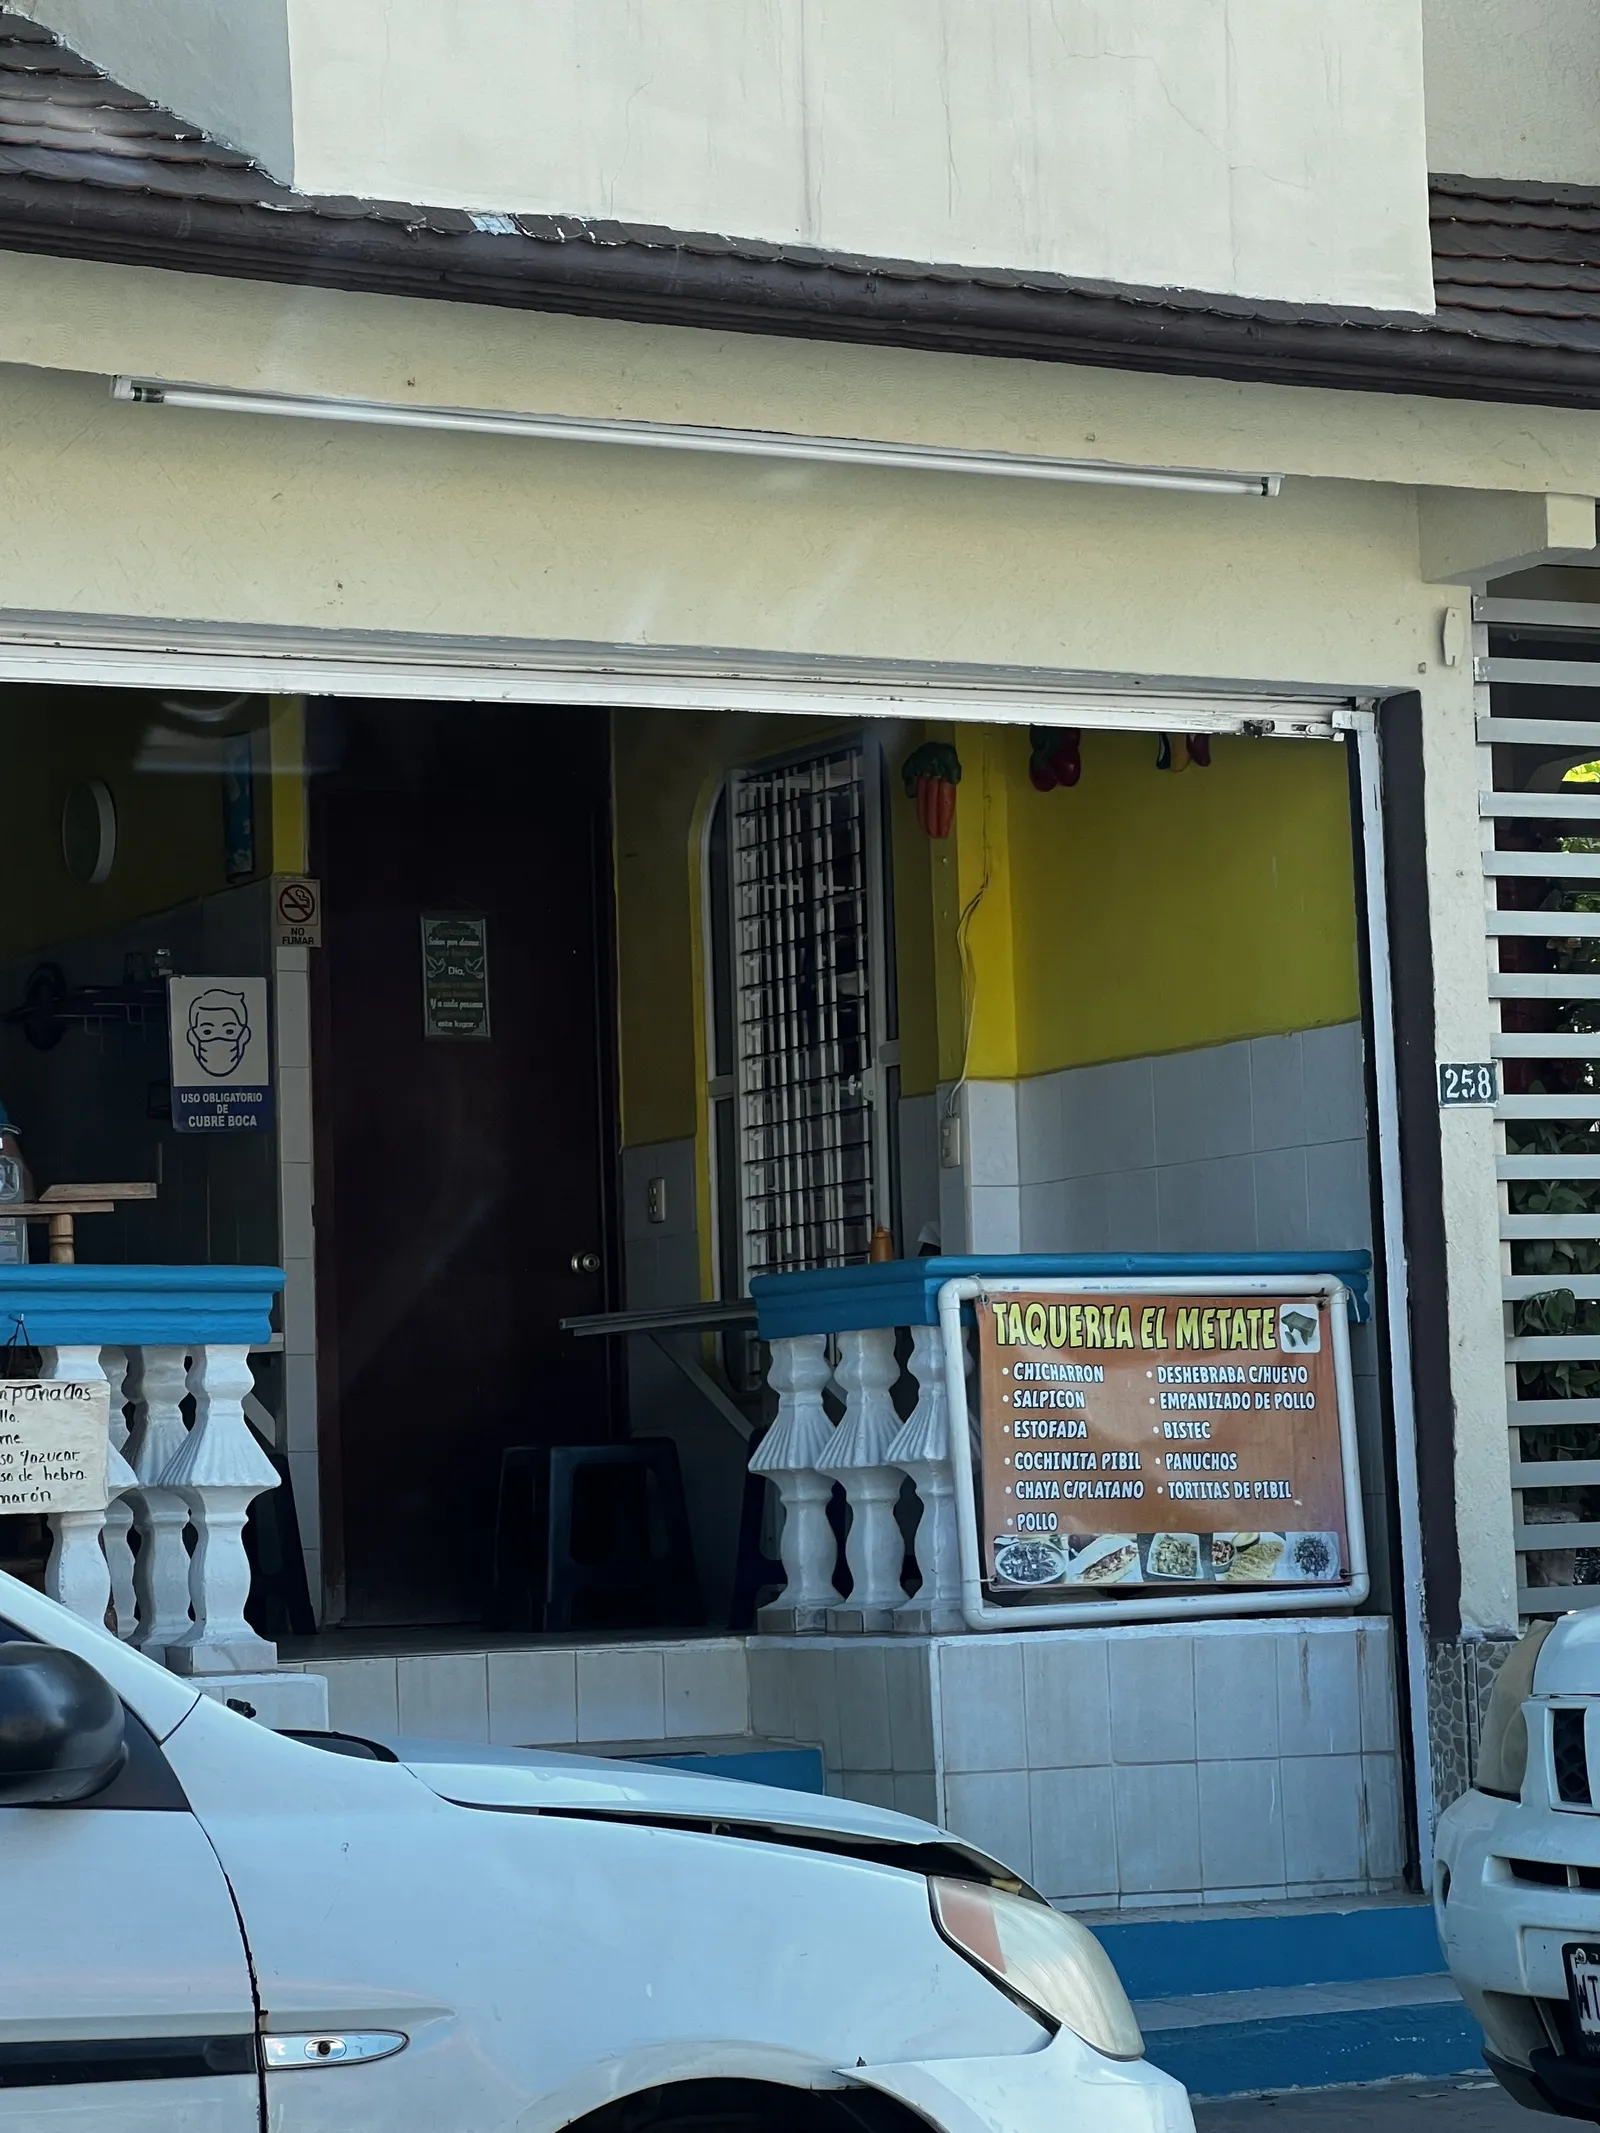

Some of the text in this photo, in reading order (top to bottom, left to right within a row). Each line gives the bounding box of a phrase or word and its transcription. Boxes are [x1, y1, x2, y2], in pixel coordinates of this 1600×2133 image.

[282, 936, 314, 945] FUMAR
[290, 927, 305, 936] NO
[1445, 1065, 1491, 1099] 258
[181, 1092, 263, 1103] USO OBLIGATORIO
[216, 1104, 229, 1114] DE
[188, 1114, 257, 1127] CUBRE BOCA
[991, 1302, 1277, 1350] TAQUERIA EL METATE
[1012, 1361, 1105, 1383] CHICHARRON
[1156, 1365, 1309, 1384] DESHEBRABA C/HUEVO
[1012, 1389, 1086, 1409] SALPICON
[1159, 1392, 1316, 1410] EMPANIZADO DE POLLO
[1012, 1419, 1088, 1439] ESTOFADA
[1162, 1421, 1212, 1440] BISTEC
[1013, 1451, 1143, 1471] COCHINITA PIBIL
[1164, 1452, 1239, 1471] PANUCHOS
[18, 1467, 33, 1482] de
[1014, 1480, 1145, 1499] CHAYA C/PLATANO
[1167, 1481, 1293, 1499] TORTITAS DE PIBIL
[1016, 1512, 1059, 1532] POLLO
